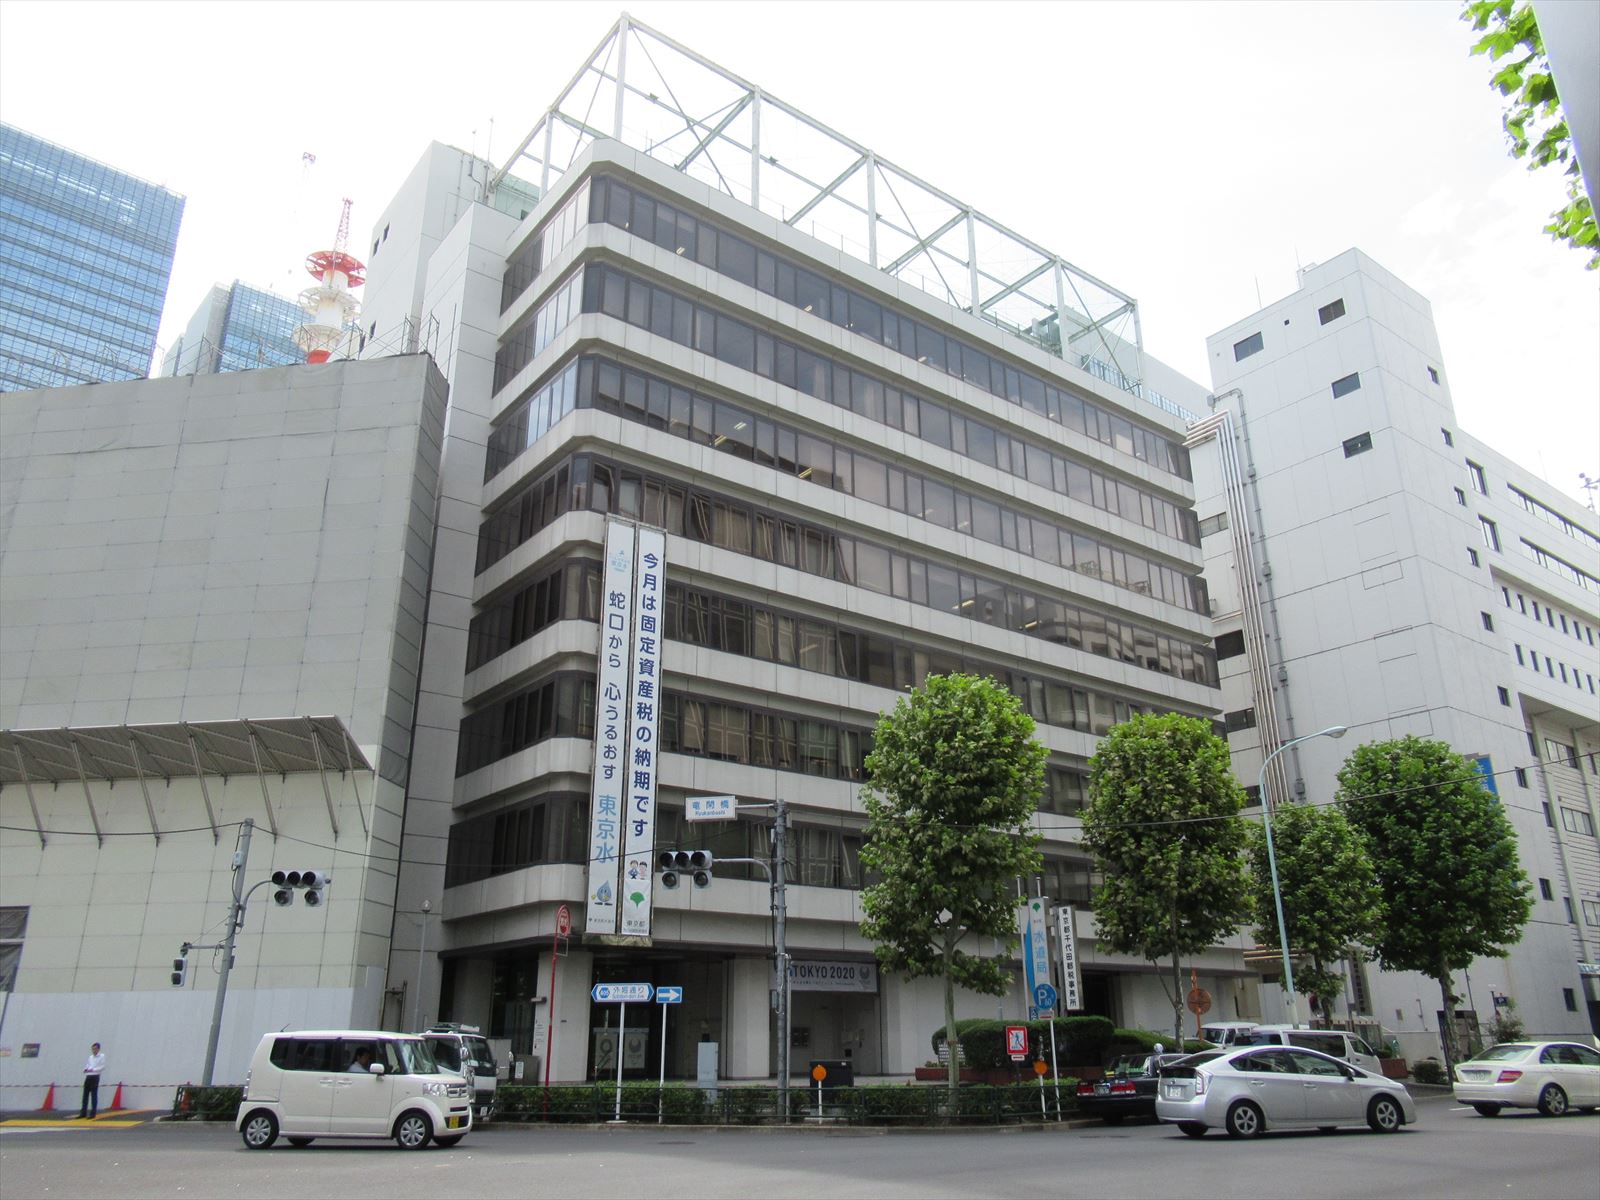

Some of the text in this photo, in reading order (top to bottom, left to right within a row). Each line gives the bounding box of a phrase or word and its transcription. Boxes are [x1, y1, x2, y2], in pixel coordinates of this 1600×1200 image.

[608, 590, 626, 668] 蛇口から
[602, 682, 621, 779] 心うるおす
[632, 553, 659, 836] 今月は固定資産税の納期です
[595, 794, 617, 863] 東京水
[793, 965, 855, 979] TOKYO 2020
[1034, 930, 1047, 974] 水道局
[1062, 908, 1077, 1007] 東京都千代田都税事務所
